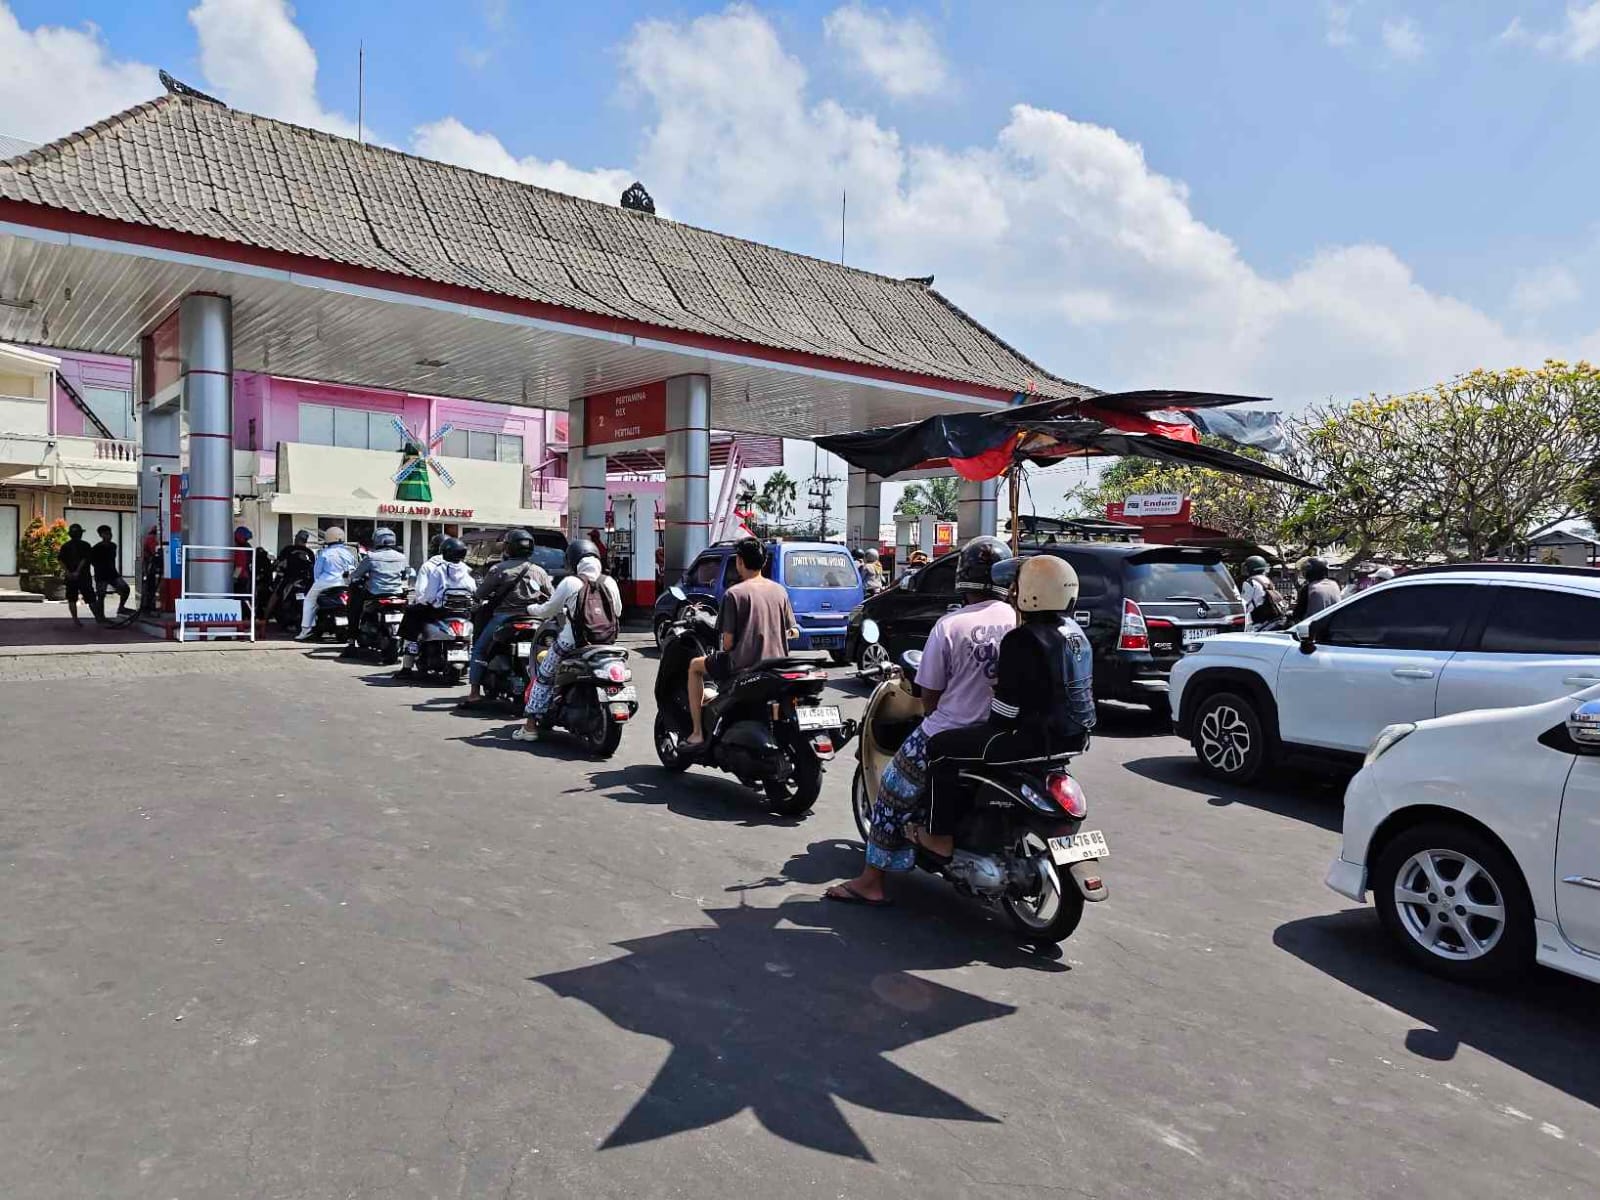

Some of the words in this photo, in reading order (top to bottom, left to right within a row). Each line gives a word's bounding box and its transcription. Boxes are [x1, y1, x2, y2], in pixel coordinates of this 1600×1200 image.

[615, 392, 646, 405] PERTAMINA
[599, 416, 604, 426] 2
[379, 504, 430, 515] HOLLAND
[432, 507, 474, 517] BAKERY
